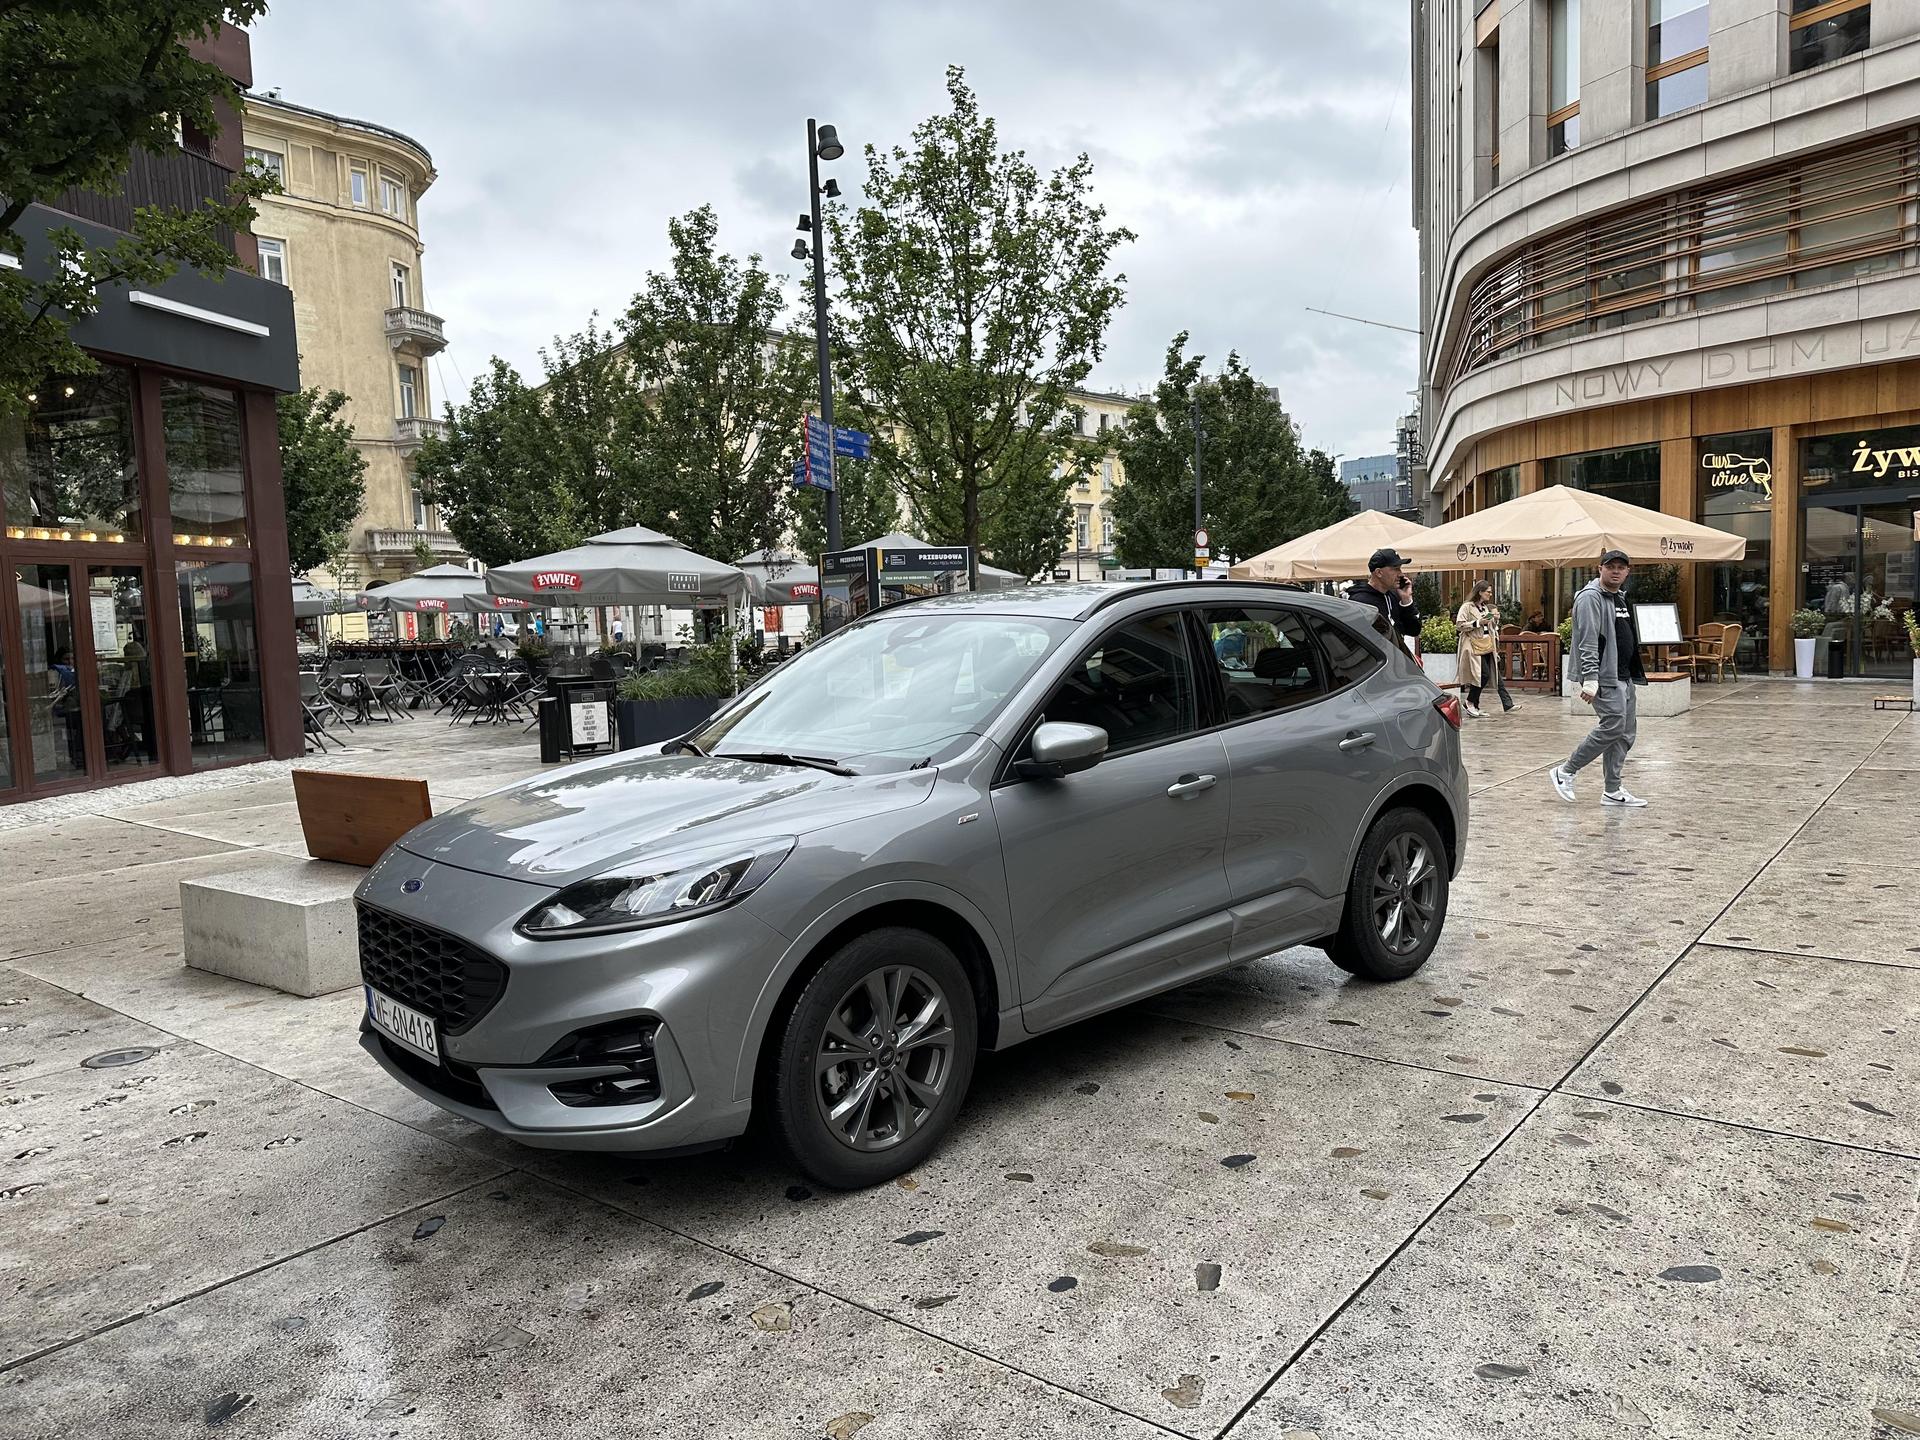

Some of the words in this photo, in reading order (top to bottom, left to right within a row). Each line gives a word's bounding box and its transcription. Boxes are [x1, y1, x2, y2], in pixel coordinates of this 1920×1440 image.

[1556, 360, 1674, 406] NOWY
[1707, 334, 1826, 380] DOM
[1711, 470, 1749, 487] wine
[1898, 469, 1919, 478] BIS
[918, 553, 963, 561] PRZEBUDOWA
[536, 573, 577, 586] ŻYWIEC
[793, 584, 819, 596] ŻYWIEC
[419, 599, 446, 609] ŻYWIEC
[393, 1005, 434, 1052] 6N418
